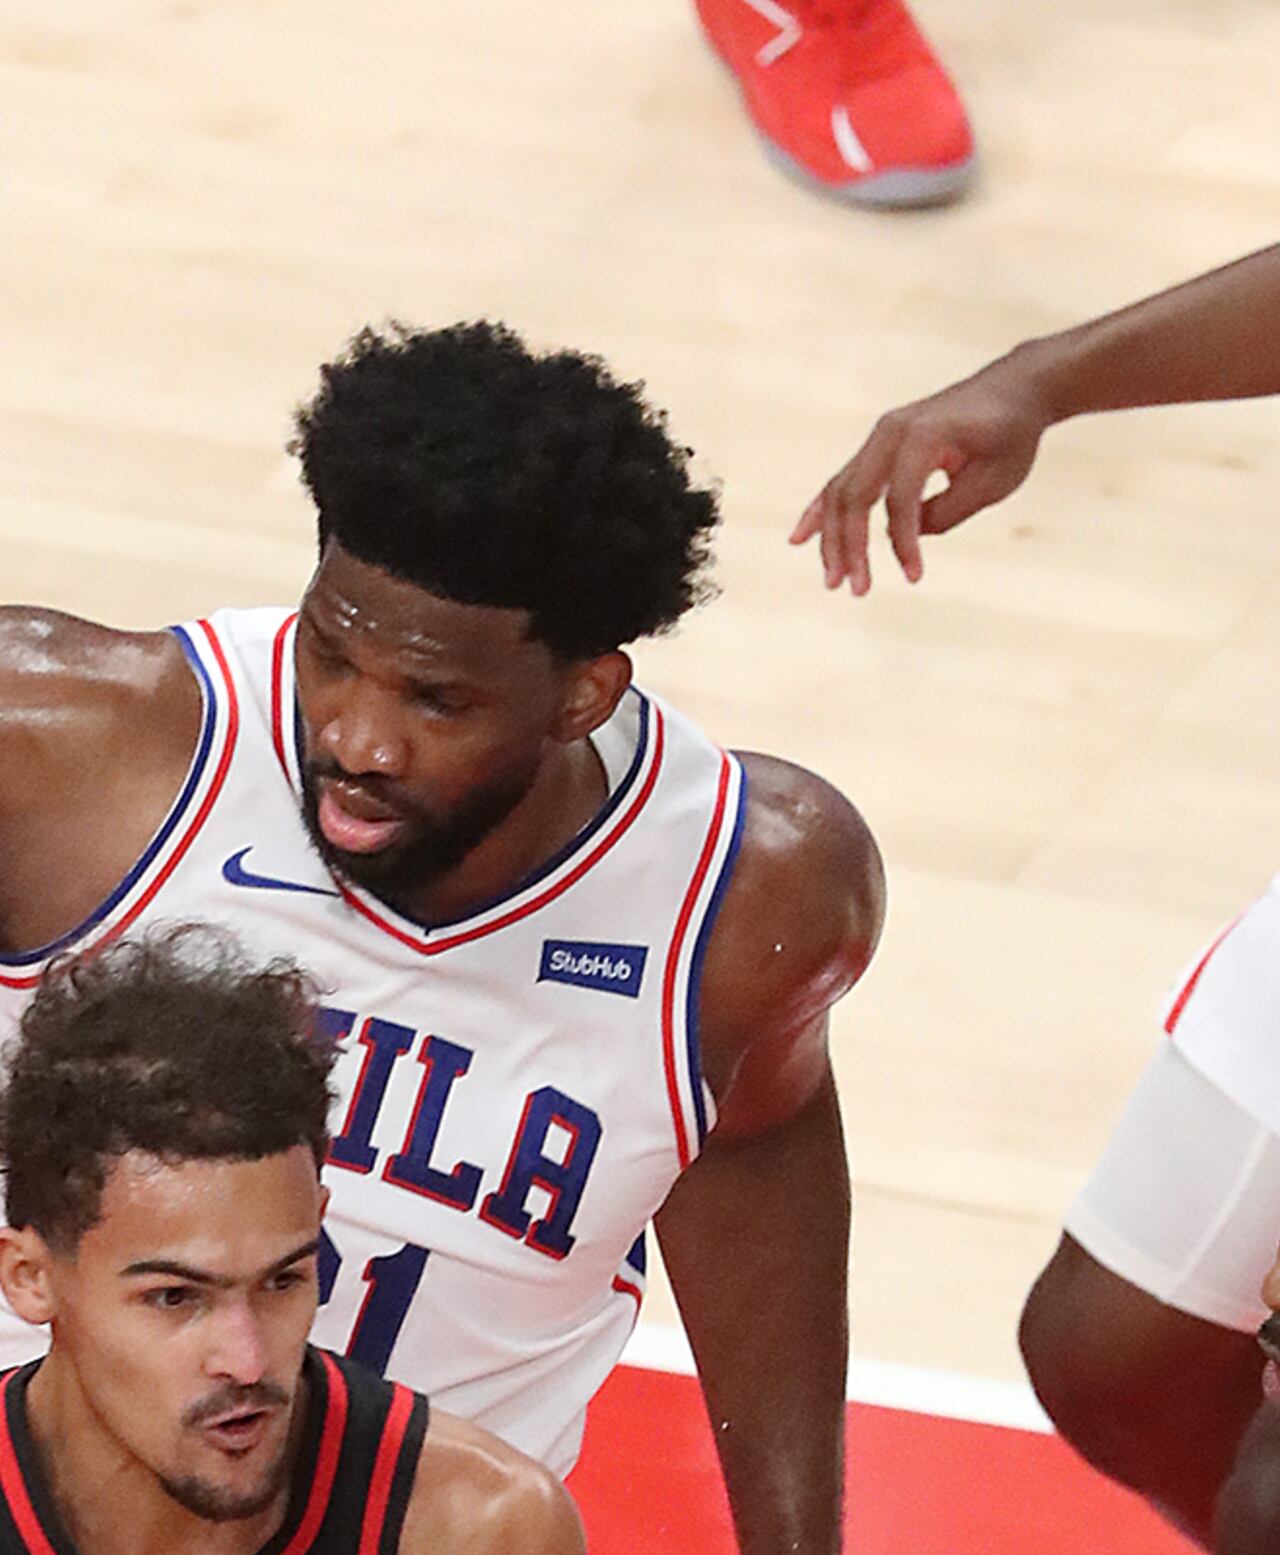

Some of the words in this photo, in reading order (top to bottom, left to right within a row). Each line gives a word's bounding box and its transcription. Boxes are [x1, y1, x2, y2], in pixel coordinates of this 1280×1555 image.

[548, 950, 632, 981] StubHub
[312, 1006, 603, 1263] ILA
[317, 1222, 432, 1379] 1
